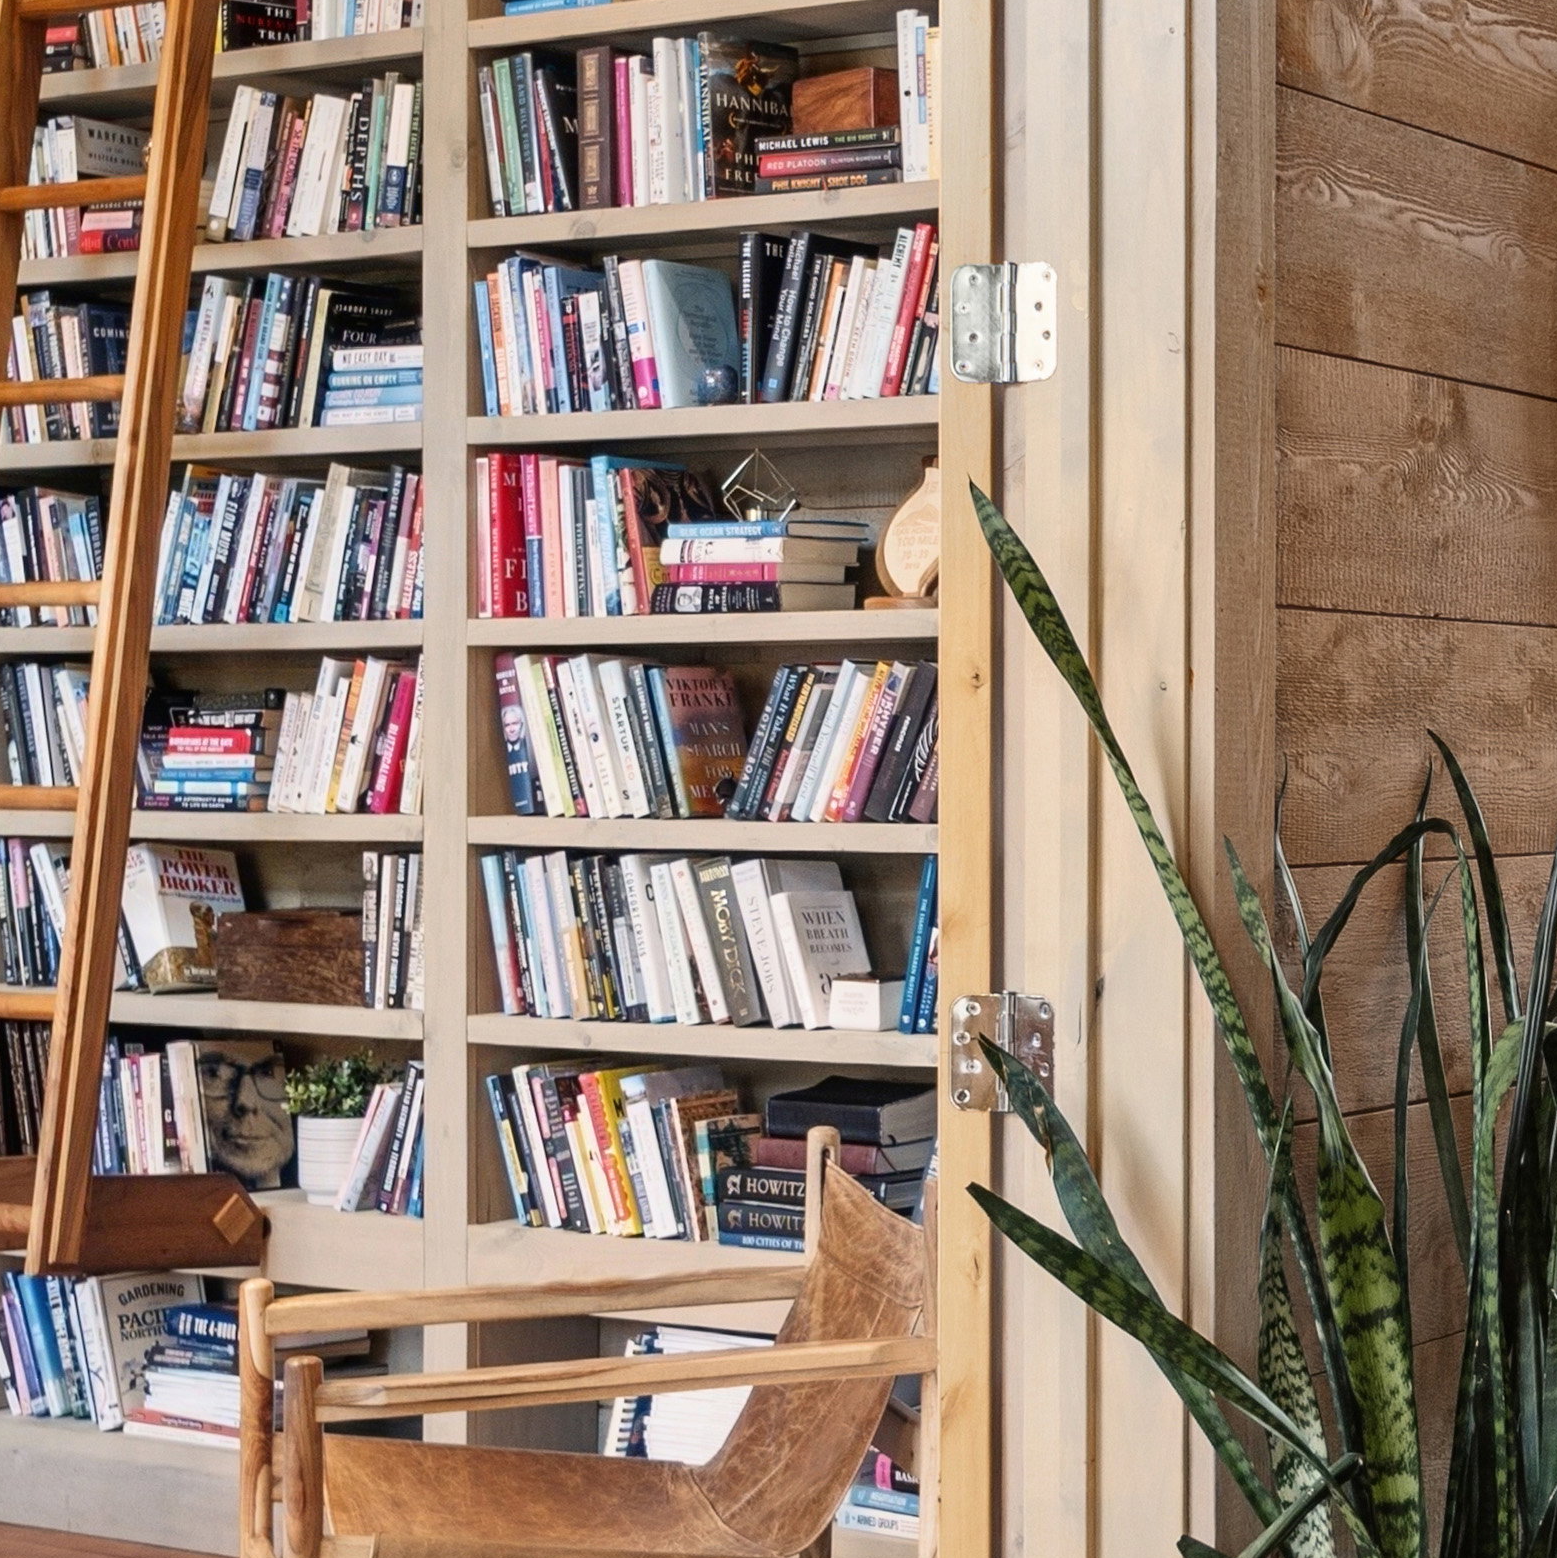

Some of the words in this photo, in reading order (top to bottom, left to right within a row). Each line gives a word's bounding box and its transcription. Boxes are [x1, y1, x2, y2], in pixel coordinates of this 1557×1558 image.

[264, 7, 292, 19] THE
[514, 56, 525, 80] RISE
[516, 84, 526, 103] AND
[699, 64, 711, 143] HANNIBAL
[519, 107, 529, 129] KILL
[88, 129, 140, 147] WARFARE
[522, 133, 532, 164] FIRST
[758, 139, 798, 151] MICHAEL
[800, 136, 829, 147] LEWIS
[858, 133, 877, 141] SHORT
[350, 116, 370, 201] DEPTHS
[766, 161, 783, 170] RED
[787, 159, 827, 169] PLATOON
[772, 180, 790, 191] PHIL
[791, 177, 822, 189] KNIGHT
[828, 176, 848, 187] SHOE
[850, 174, 868, 185] DOG
[742, 242, 750, 257] THE
[785, 238, 797, 270] Pollan
[791, 239, 805, 281] Michael
[892, 235, 908, 269] ALCHEMY
[742, 260, 750, 299] ILLEGALS
[813, 259, 821, 274] THE
[777, 288, 787, 312] Your
[809, 277, 818, 300] GOOD
[786, 290, 796, 314] How
[601, 311, 611, 341] Taliban
[772, 314, 784, 341] Mind
[784, 316, 793, 326] to
[803, 301, 814, 339] SOLDIERS
[342, 331, 377, 345] FOUR
[777, 328, 791, 367] Change
[342, 351, 352, 363] NO
[354, 351, 371, 363] EASY
[372, 351, 388, 363] DAY
[332, 375, 362, 386] RUNNING
[363, 375, 372, 385] ON
[374, 373, 398, 384] EMPTY
[491, 460, 499, 489] FLASH
[525, 463, 536, 504] Michael
[388, 472, 401, 518] ENDURE
[491, 491, 499, 515] BOYS
[222, 501, 238, 528] ELON
[527, 505, 537, 533] Lewis
[680, 525, 698, 537] BLUE
[700, 525, 723, 537] OCEAN
[724, 525, 762, 536] STRATEGY
[87, 512, 102, 583] ENDURANCE
[215, 530, 232, 564] MUSK
[575, 523, 585, 598] FORGETTING
[401, 549, 418, 609] RELENTLESS
[412, 589, 422, 611] the
[668, 693, 733, 708] FRANKL
[784, 674, 797, 702] What
[313, 694, 324, 720] BUILD
[778, 703, 788, 713] It
[823, 702, 839, 728] Lead
[871, 698, 888, 732] PASS
[688, 722, 728, 735] MAN'S
[756, 705, 773, 736] BOYS
[769, 715, 786, 743] Takes
[870, 701, 894, 755] KHYBER
[612, 695, 630, 753] STARTUP
[623, 755, 635, 781] CEO
[686, 743, 742, 758] SEARCH
[376, 723, 399, 793] BLITZSCALING
[807, 730, 831, 773] Yourself
[740, 756, 757, 788] BOAT
[800, 775, 816, 799] First
[176, 849, 204, 861] THE
[162, 859, 230, 879] POWER
[396, 858, 406, 881] DAVID
[574, 868, 583, 891] TEAM
[160, 875, 238, 896] BROKER
[552, 868, 569, 928] INNOVATORS
[394, 883, 405, 919] GOGGINS
[578, 892, 589, 923] GENIUS
[624, 872, 639, 919] COMFORT
[634, 923, 646, 958] CRISIS
[710, 889, 735, 944] MOBY
[802, 909, 846, 925] WHEN
[391, 931, 401, 957] NEVER
[746, 896, 768, 951] STEVE
[758, 954, 776, 994] JOBS
[806, 929, 850, 941] BREATH
[810, 943, 852, 954] BECOMES
[388, 958, 399, 995] FINISHED
[722, 947, 746, 999] DICK
[118, 1283, 185, 1306] GARDENING
[857, 1514, 876, 1527] ARMED
[878, 1517, 899, 1531] GROUPS
